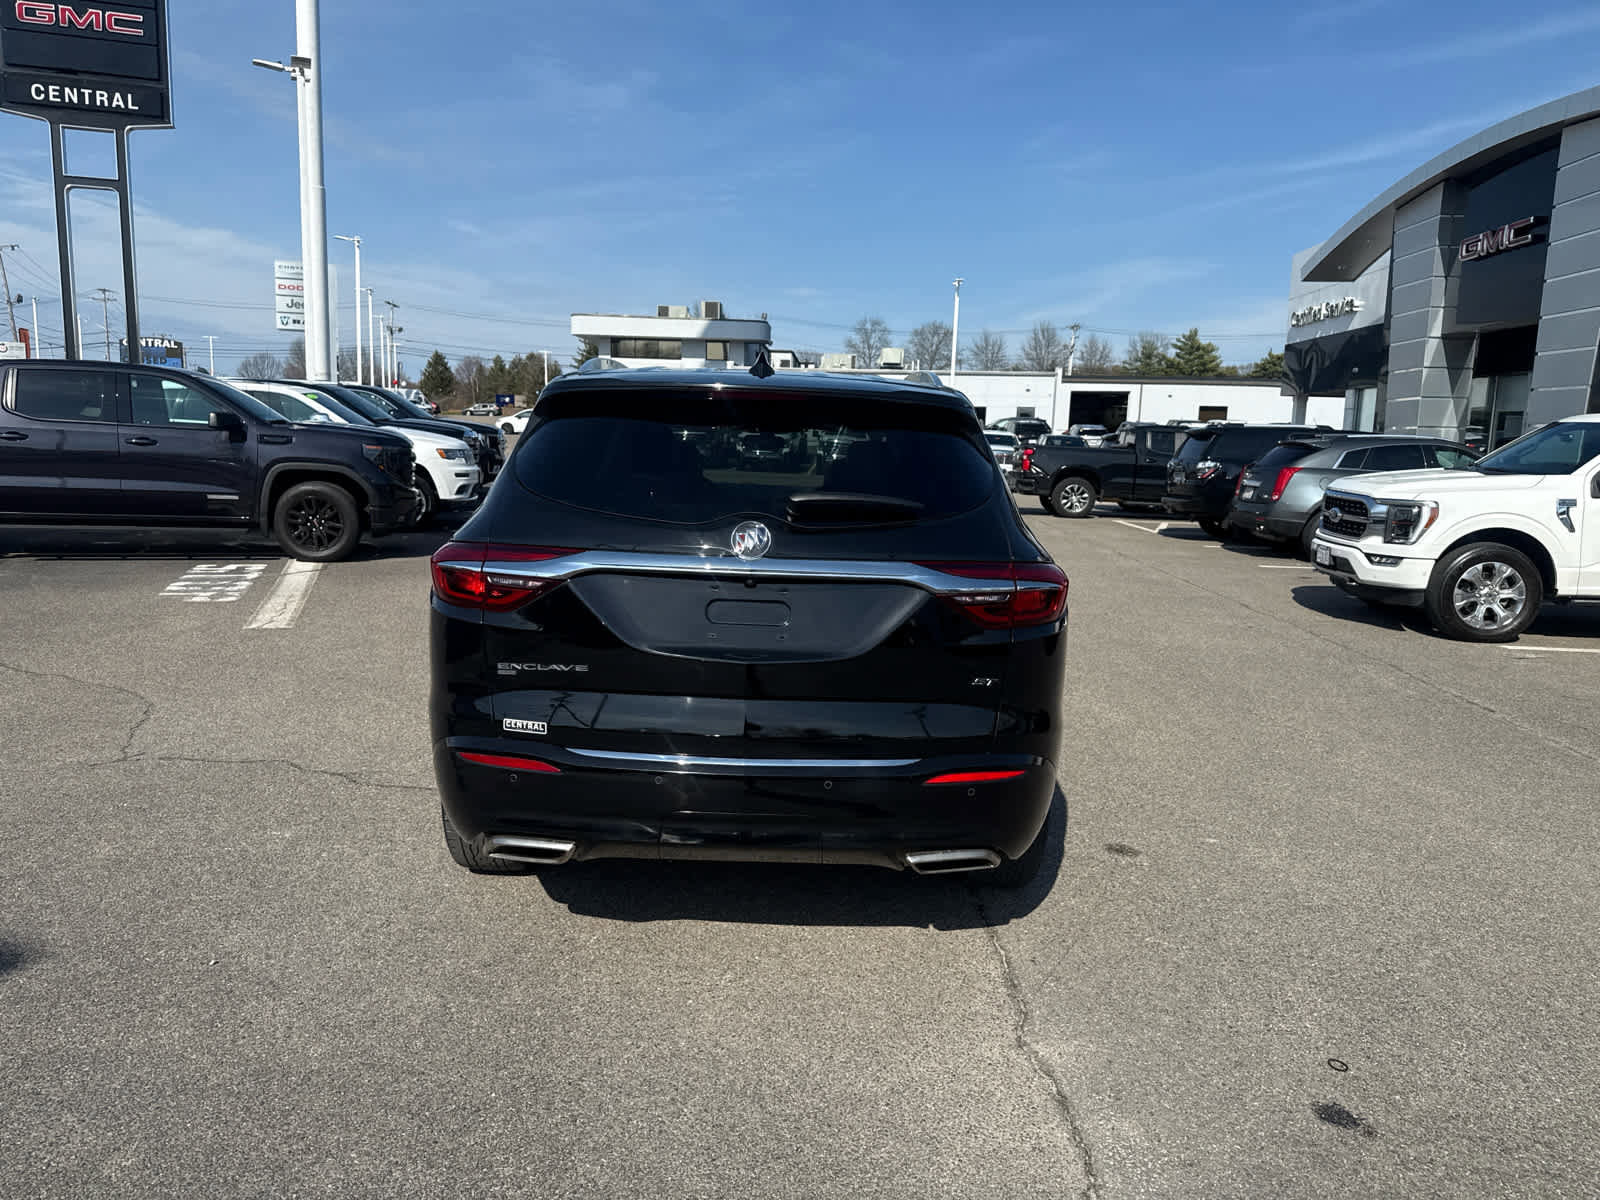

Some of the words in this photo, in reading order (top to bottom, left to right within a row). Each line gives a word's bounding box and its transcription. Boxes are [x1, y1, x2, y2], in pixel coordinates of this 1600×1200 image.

[15, 0, 144, 36] GMC
[30, 83, 140, 110] CENTRAL
[1459, 215, 1535, 261] GMC
[278, 283, 304, 291] DOD
[286, 298, 304, 310] Je
[122, 337, 179, 349] CNTRAL
[497, 662, 590, 672] ENCLAVE
[505, 720, 545, 731] CENTRAL
